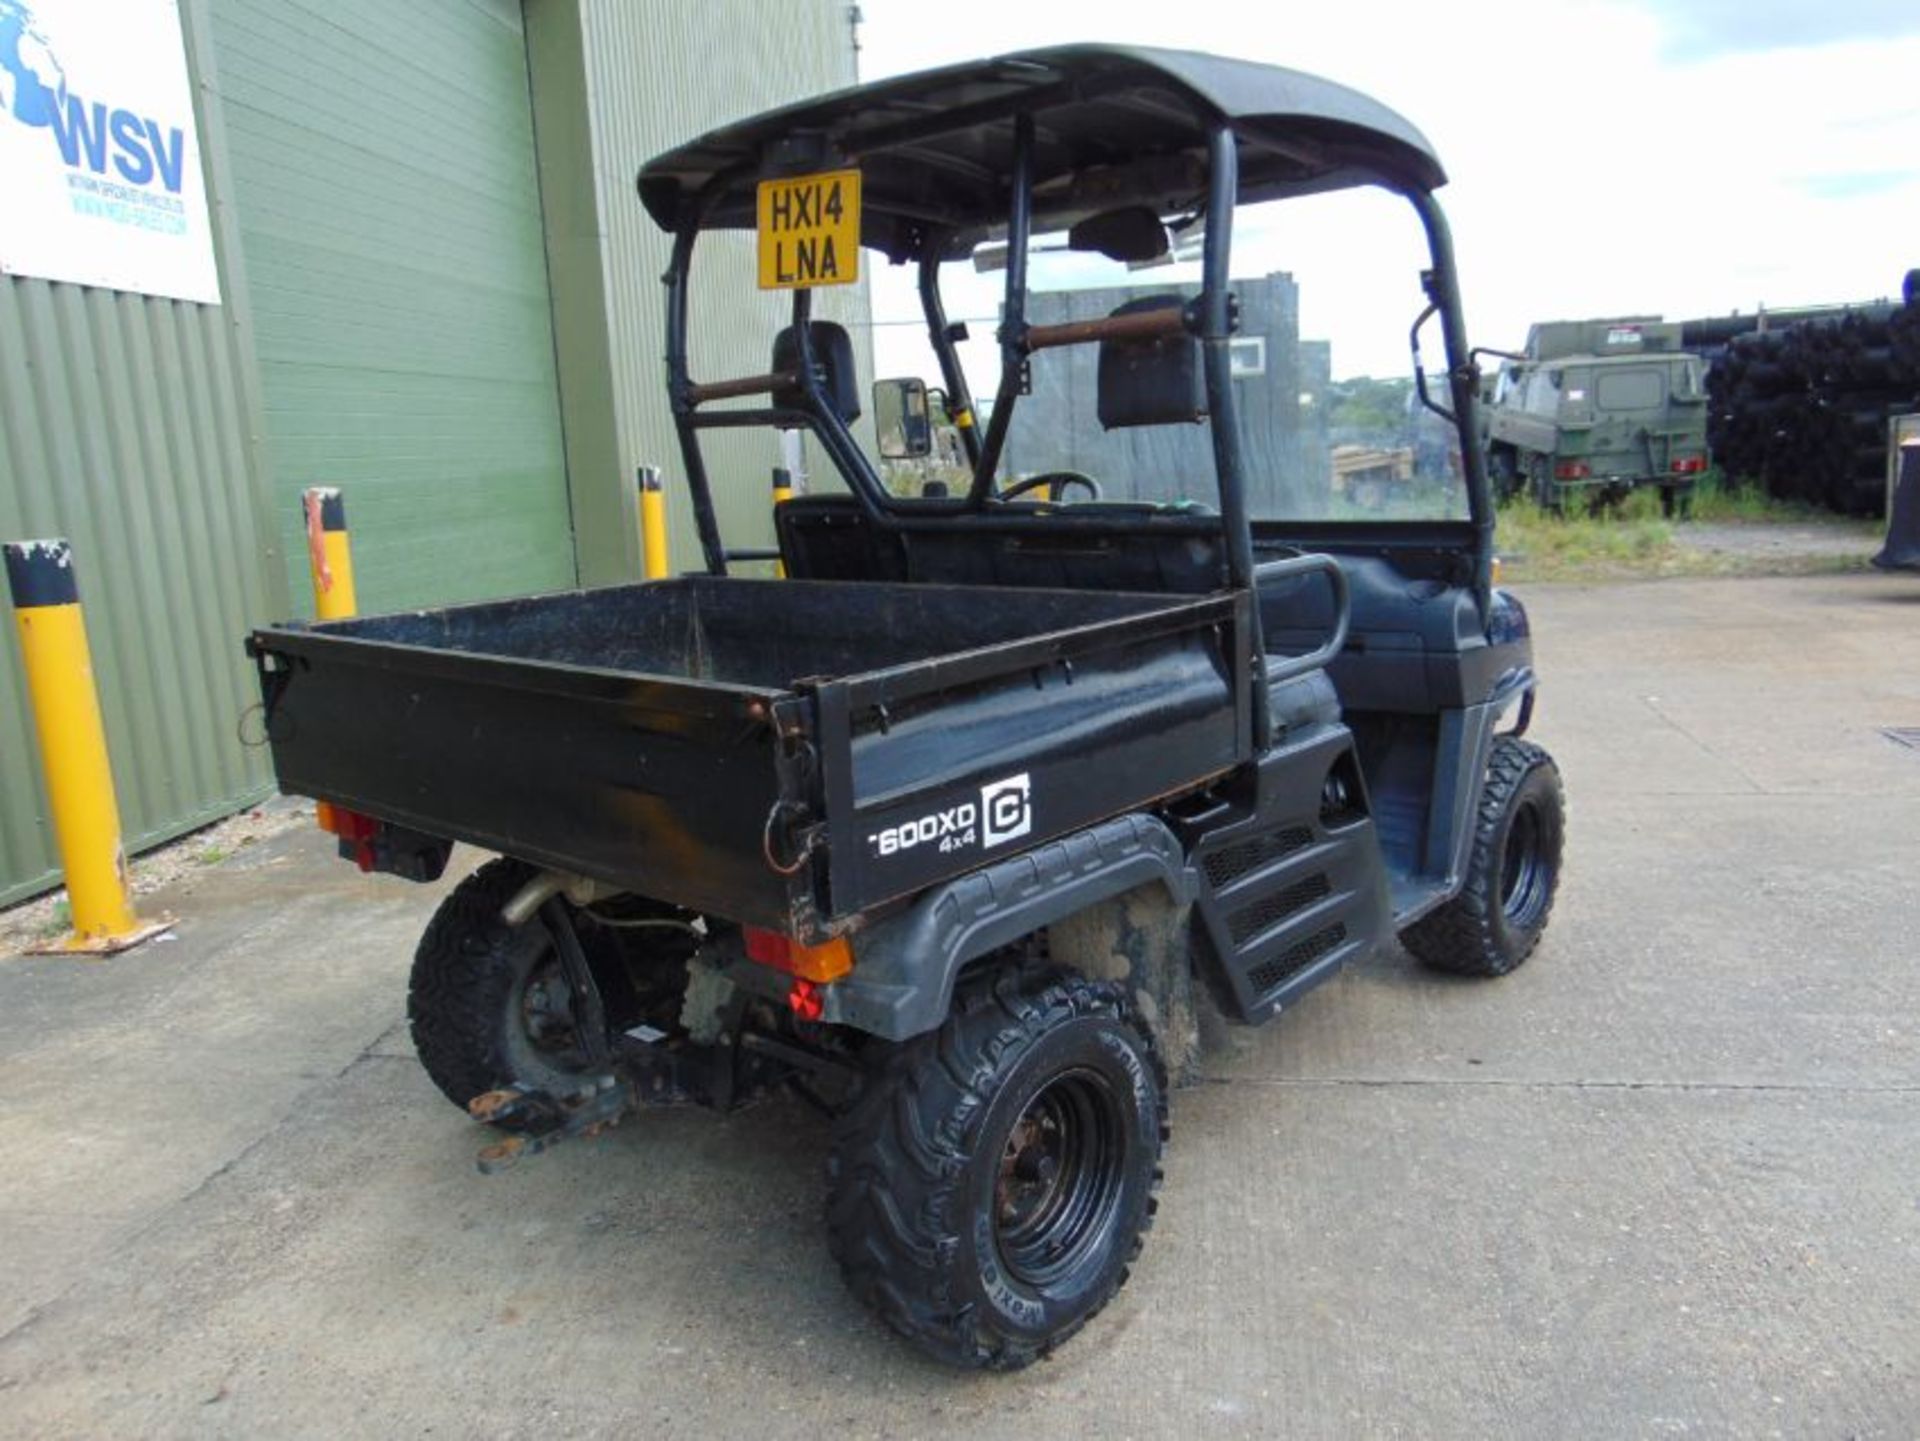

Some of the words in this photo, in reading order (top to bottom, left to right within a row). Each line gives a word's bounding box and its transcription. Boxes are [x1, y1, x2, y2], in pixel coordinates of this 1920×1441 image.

[42, 85, 184, 194] WSV
[772, 181, 843, 232] HX14
[777, 235, 837, 282] LNA
[938, 827, 976, 853] 4x4
